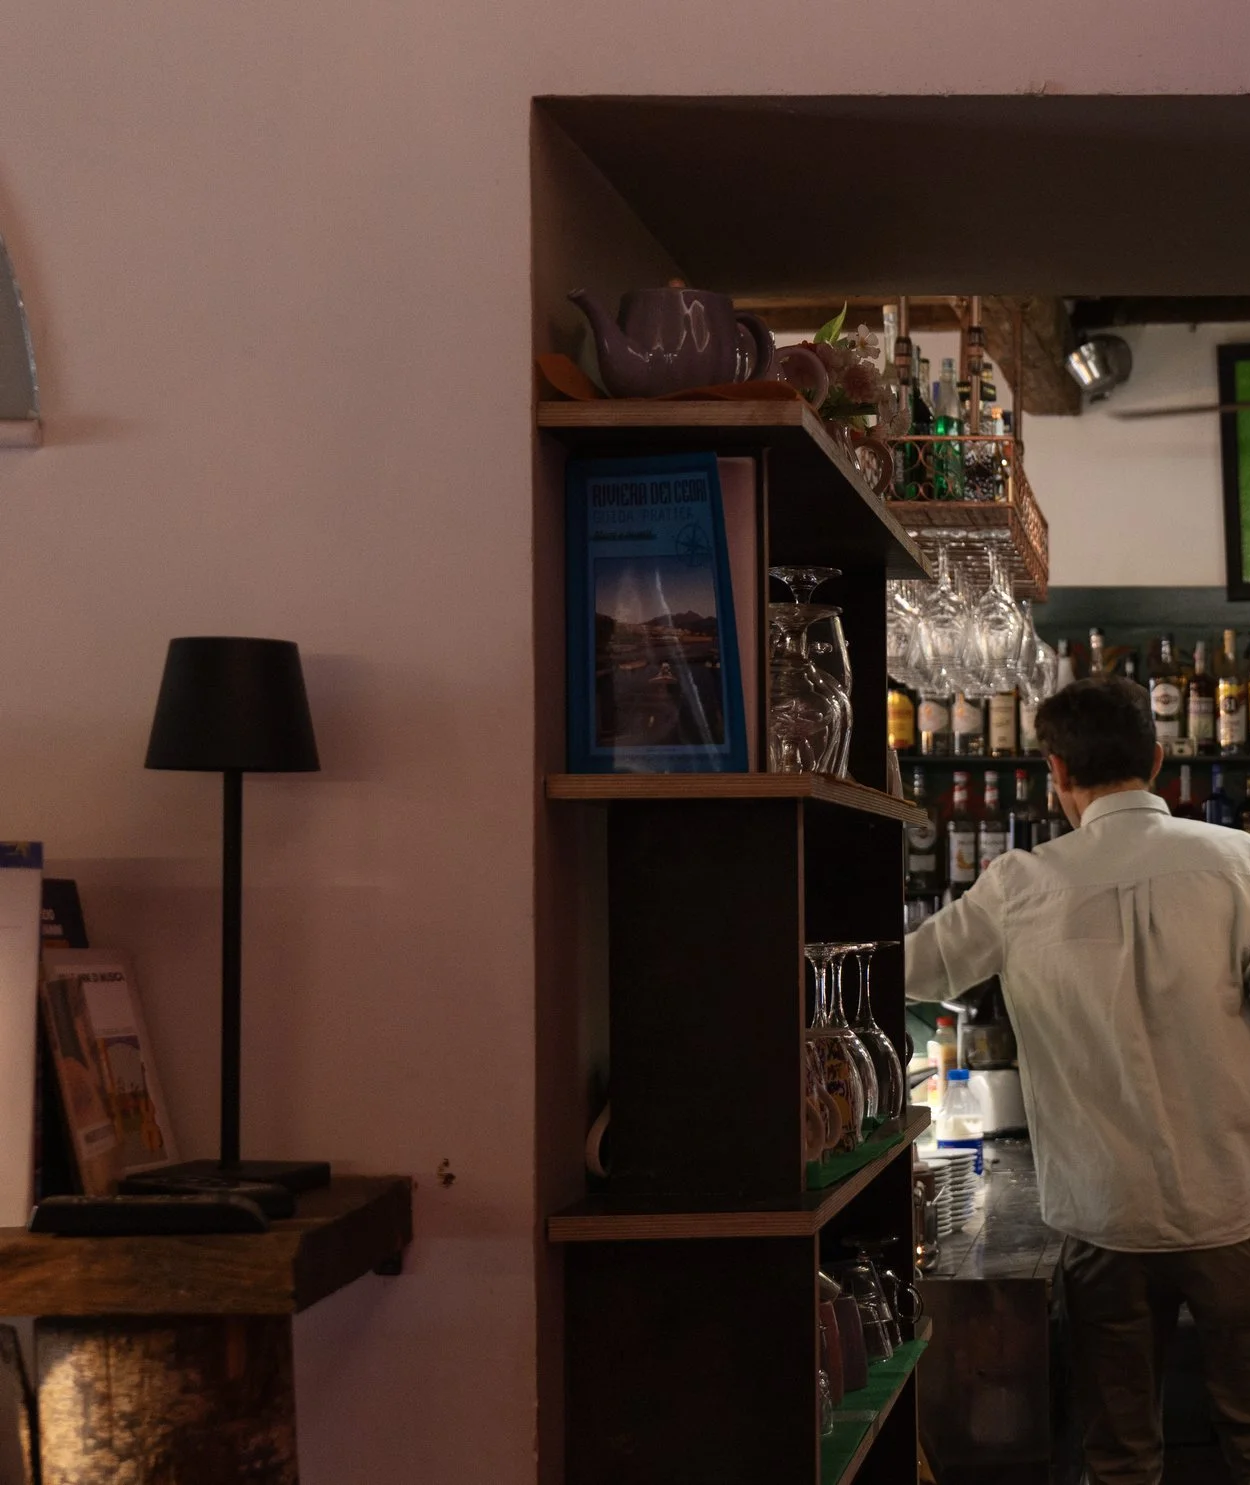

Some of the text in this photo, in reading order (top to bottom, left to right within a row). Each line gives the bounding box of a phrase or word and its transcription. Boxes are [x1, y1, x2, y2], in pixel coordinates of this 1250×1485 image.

[592, 478, 708, 508] RIVIERA DEI CEDRI
[592, 508, 634, 524] GUIDA
